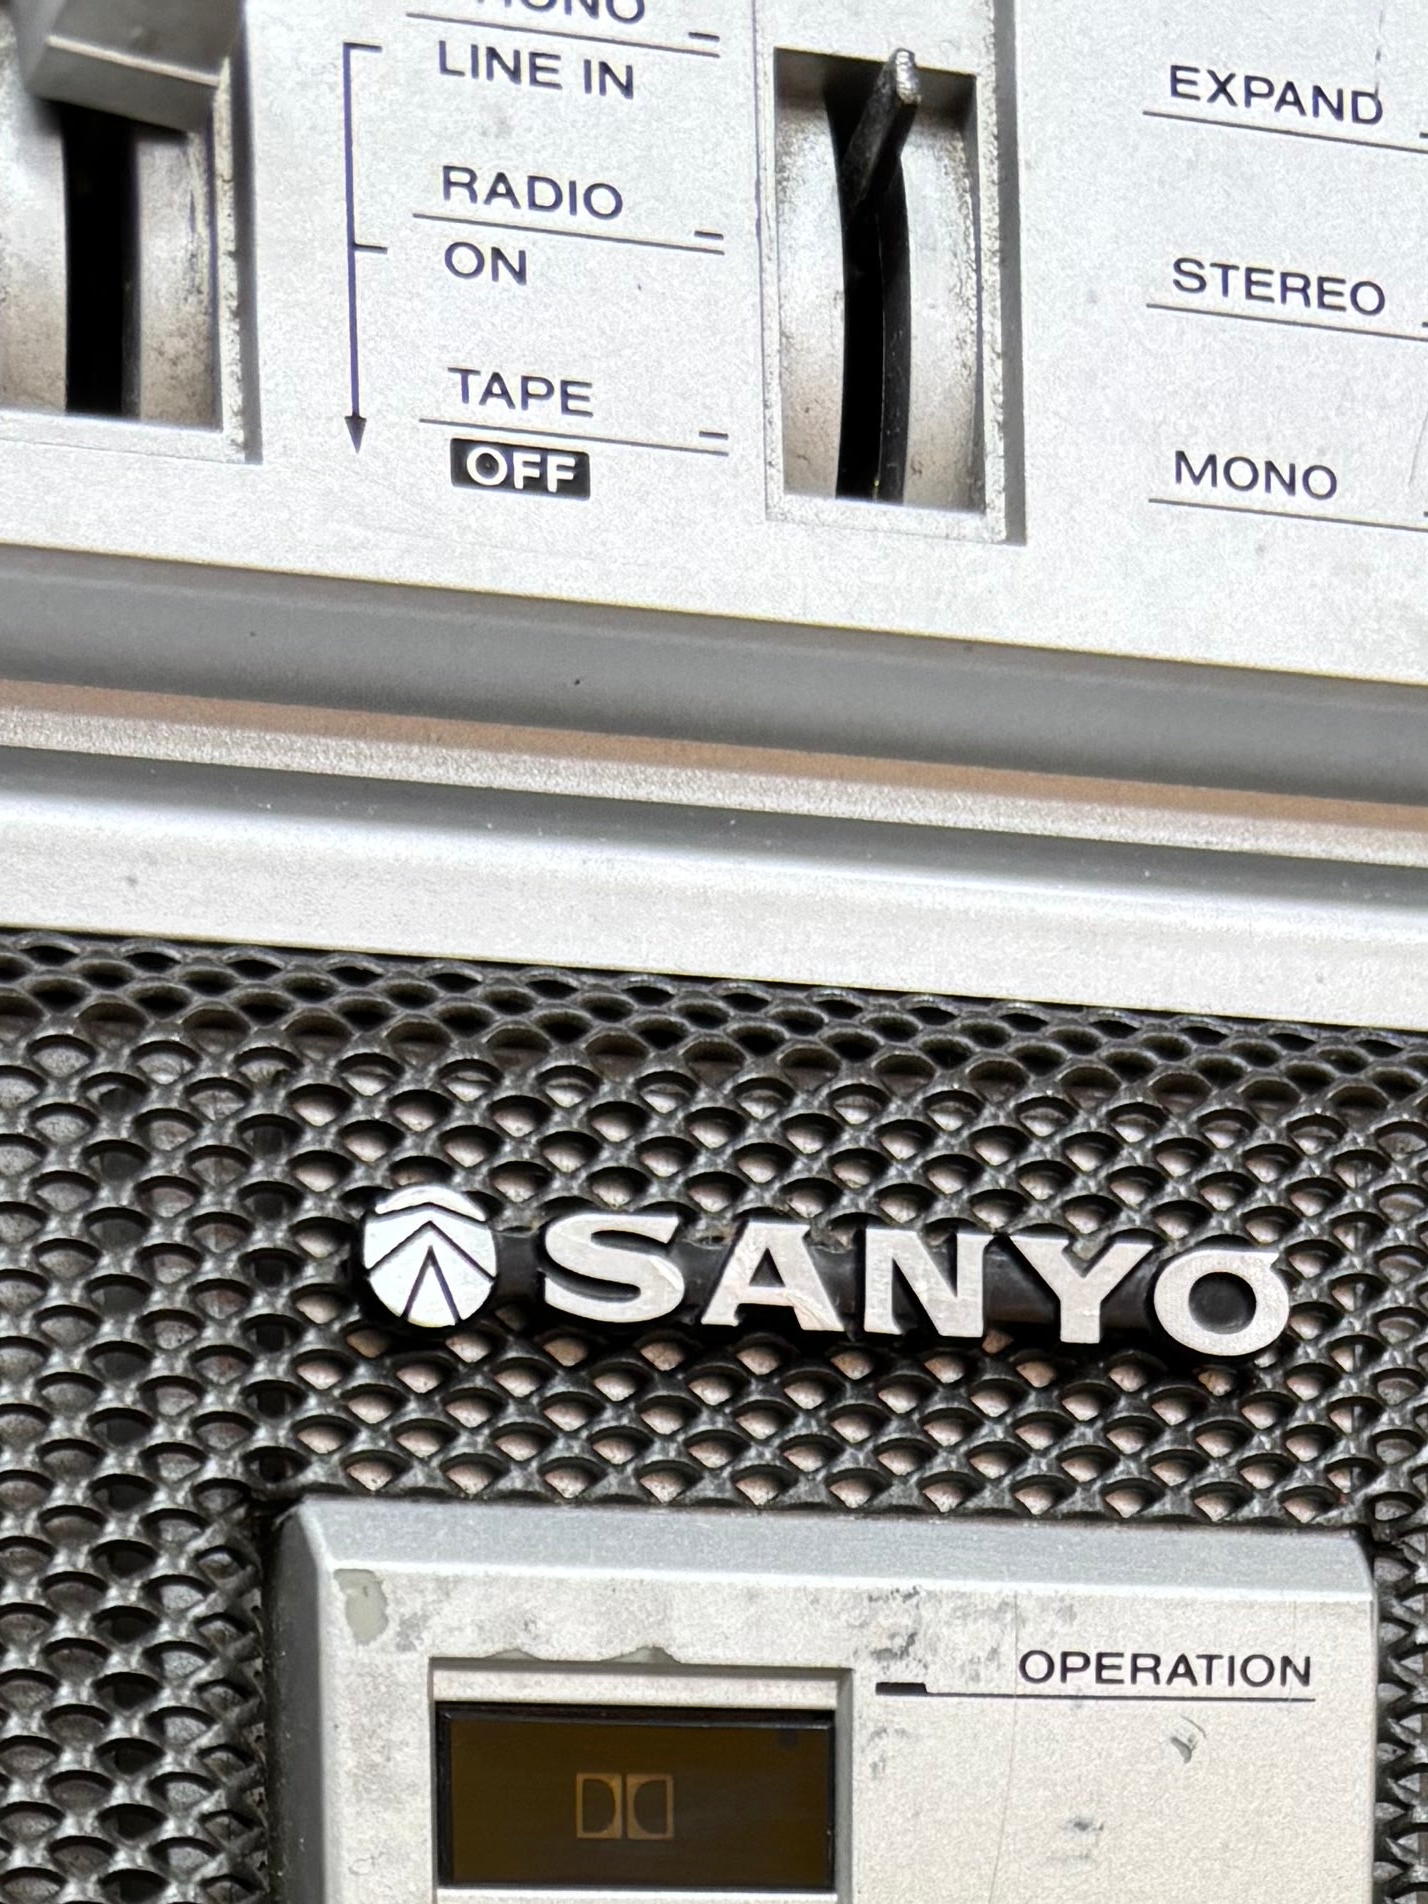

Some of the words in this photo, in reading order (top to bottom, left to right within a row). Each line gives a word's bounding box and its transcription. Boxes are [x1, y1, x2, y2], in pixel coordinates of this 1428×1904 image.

[439, 40, 562, 89] LINE
[584, 59, 633, 99] IN
[1170, 65, 1383, 125] EXPAND
[442, 165, 623, 220] RADIO
[445, 242, 526, 285] ON
[1173, 258, 1385, 315] STEREO
[448, 367, 593, 417] TAPE
[466, 446, 576, 493] OFF
[1174, 450, 1337, 499] MONO
[544, 1212, 1291, 1357] SANYO
[1019, 1650, 1310, 1687] OPERATION
